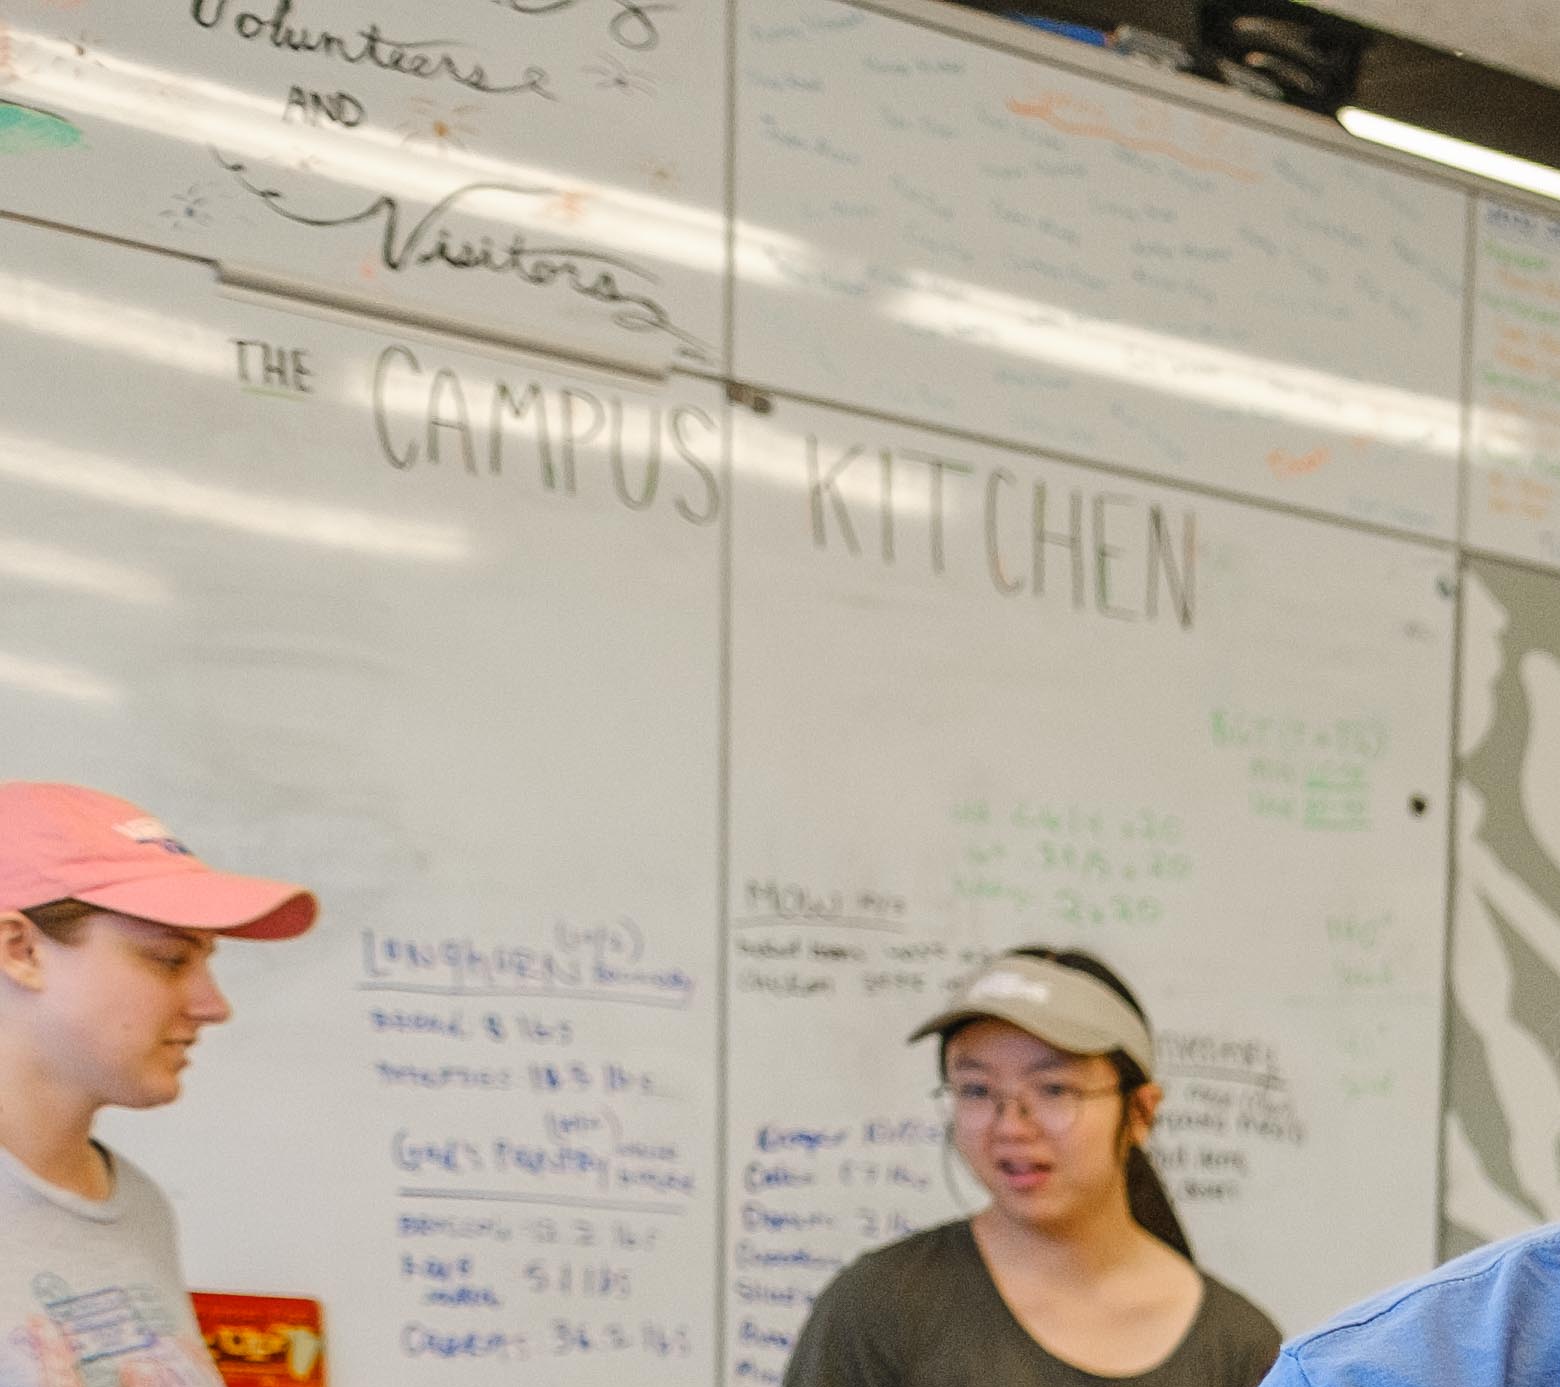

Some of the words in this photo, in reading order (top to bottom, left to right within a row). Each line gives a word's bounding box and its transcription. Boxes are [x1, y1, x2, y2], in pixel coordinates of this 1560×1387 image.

[283, 85, 365, 127] AND
[231, 340, 313, 394] THE
[371, 345, 723, 526] CAMPUS
[807, 435, 1196, 631] KITCHEN
